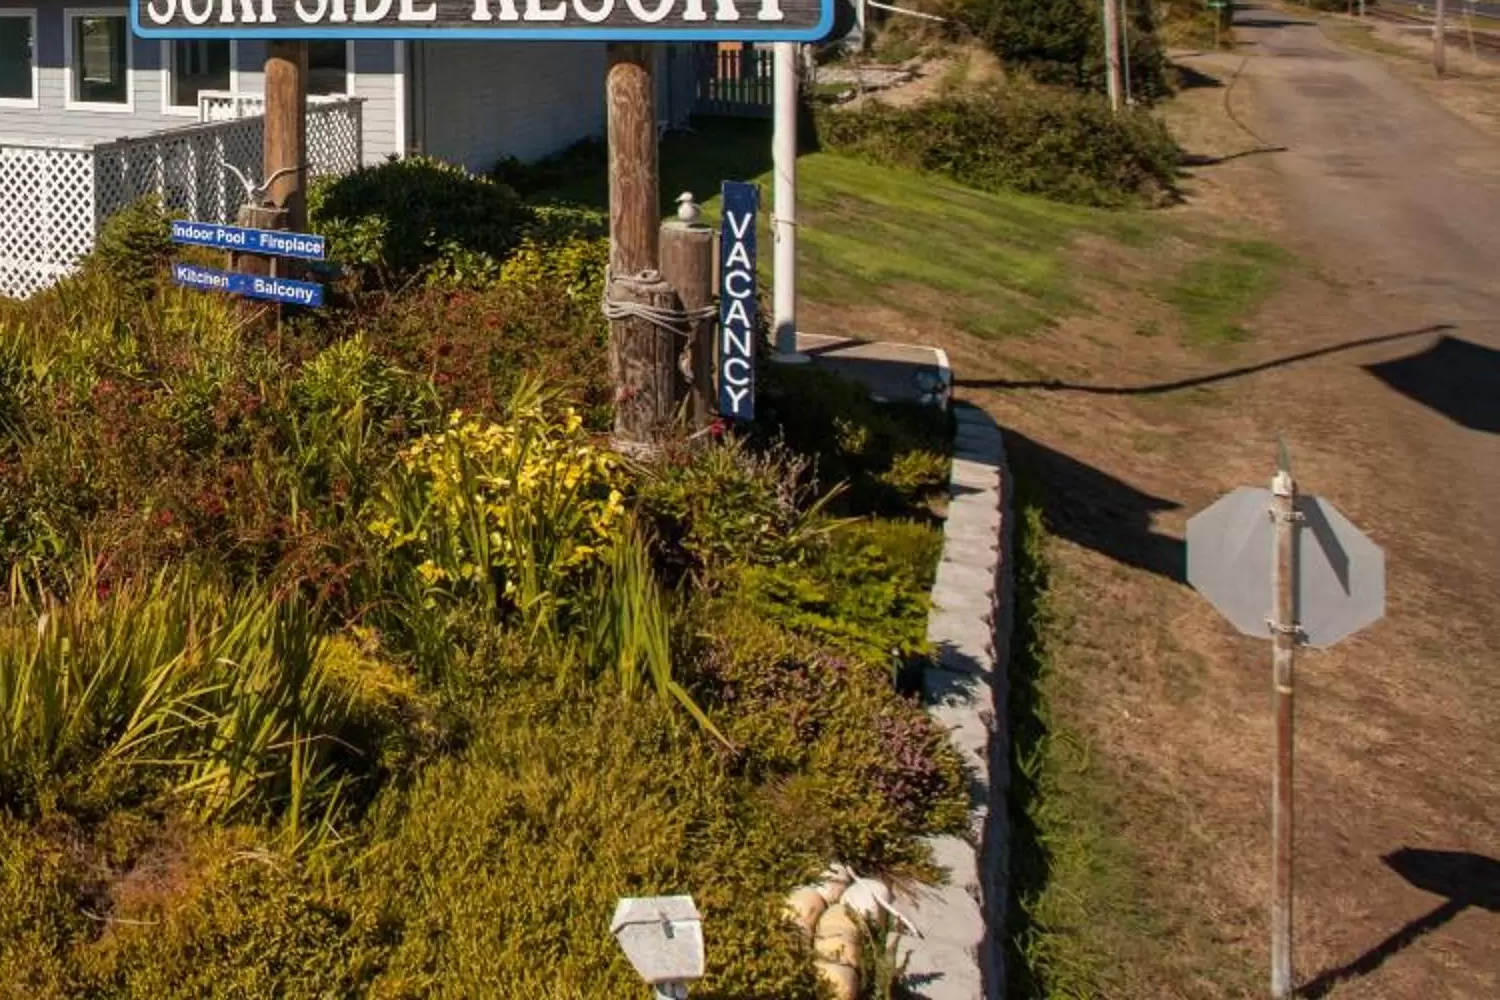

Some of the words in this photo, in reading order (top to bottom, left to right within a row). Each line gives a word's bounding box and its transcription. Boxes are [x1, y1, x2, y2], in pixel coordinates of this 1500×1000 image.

[172, 223, 213, 241] Indoor
[217, 229, 245, 244] Pool
[260, 233, 320, 253] Fireplace
[177, 267, 229, 287] Kitchen
[254, 279, 313, 302] Balcony
[723, 211, 753, 413] VACANCY
